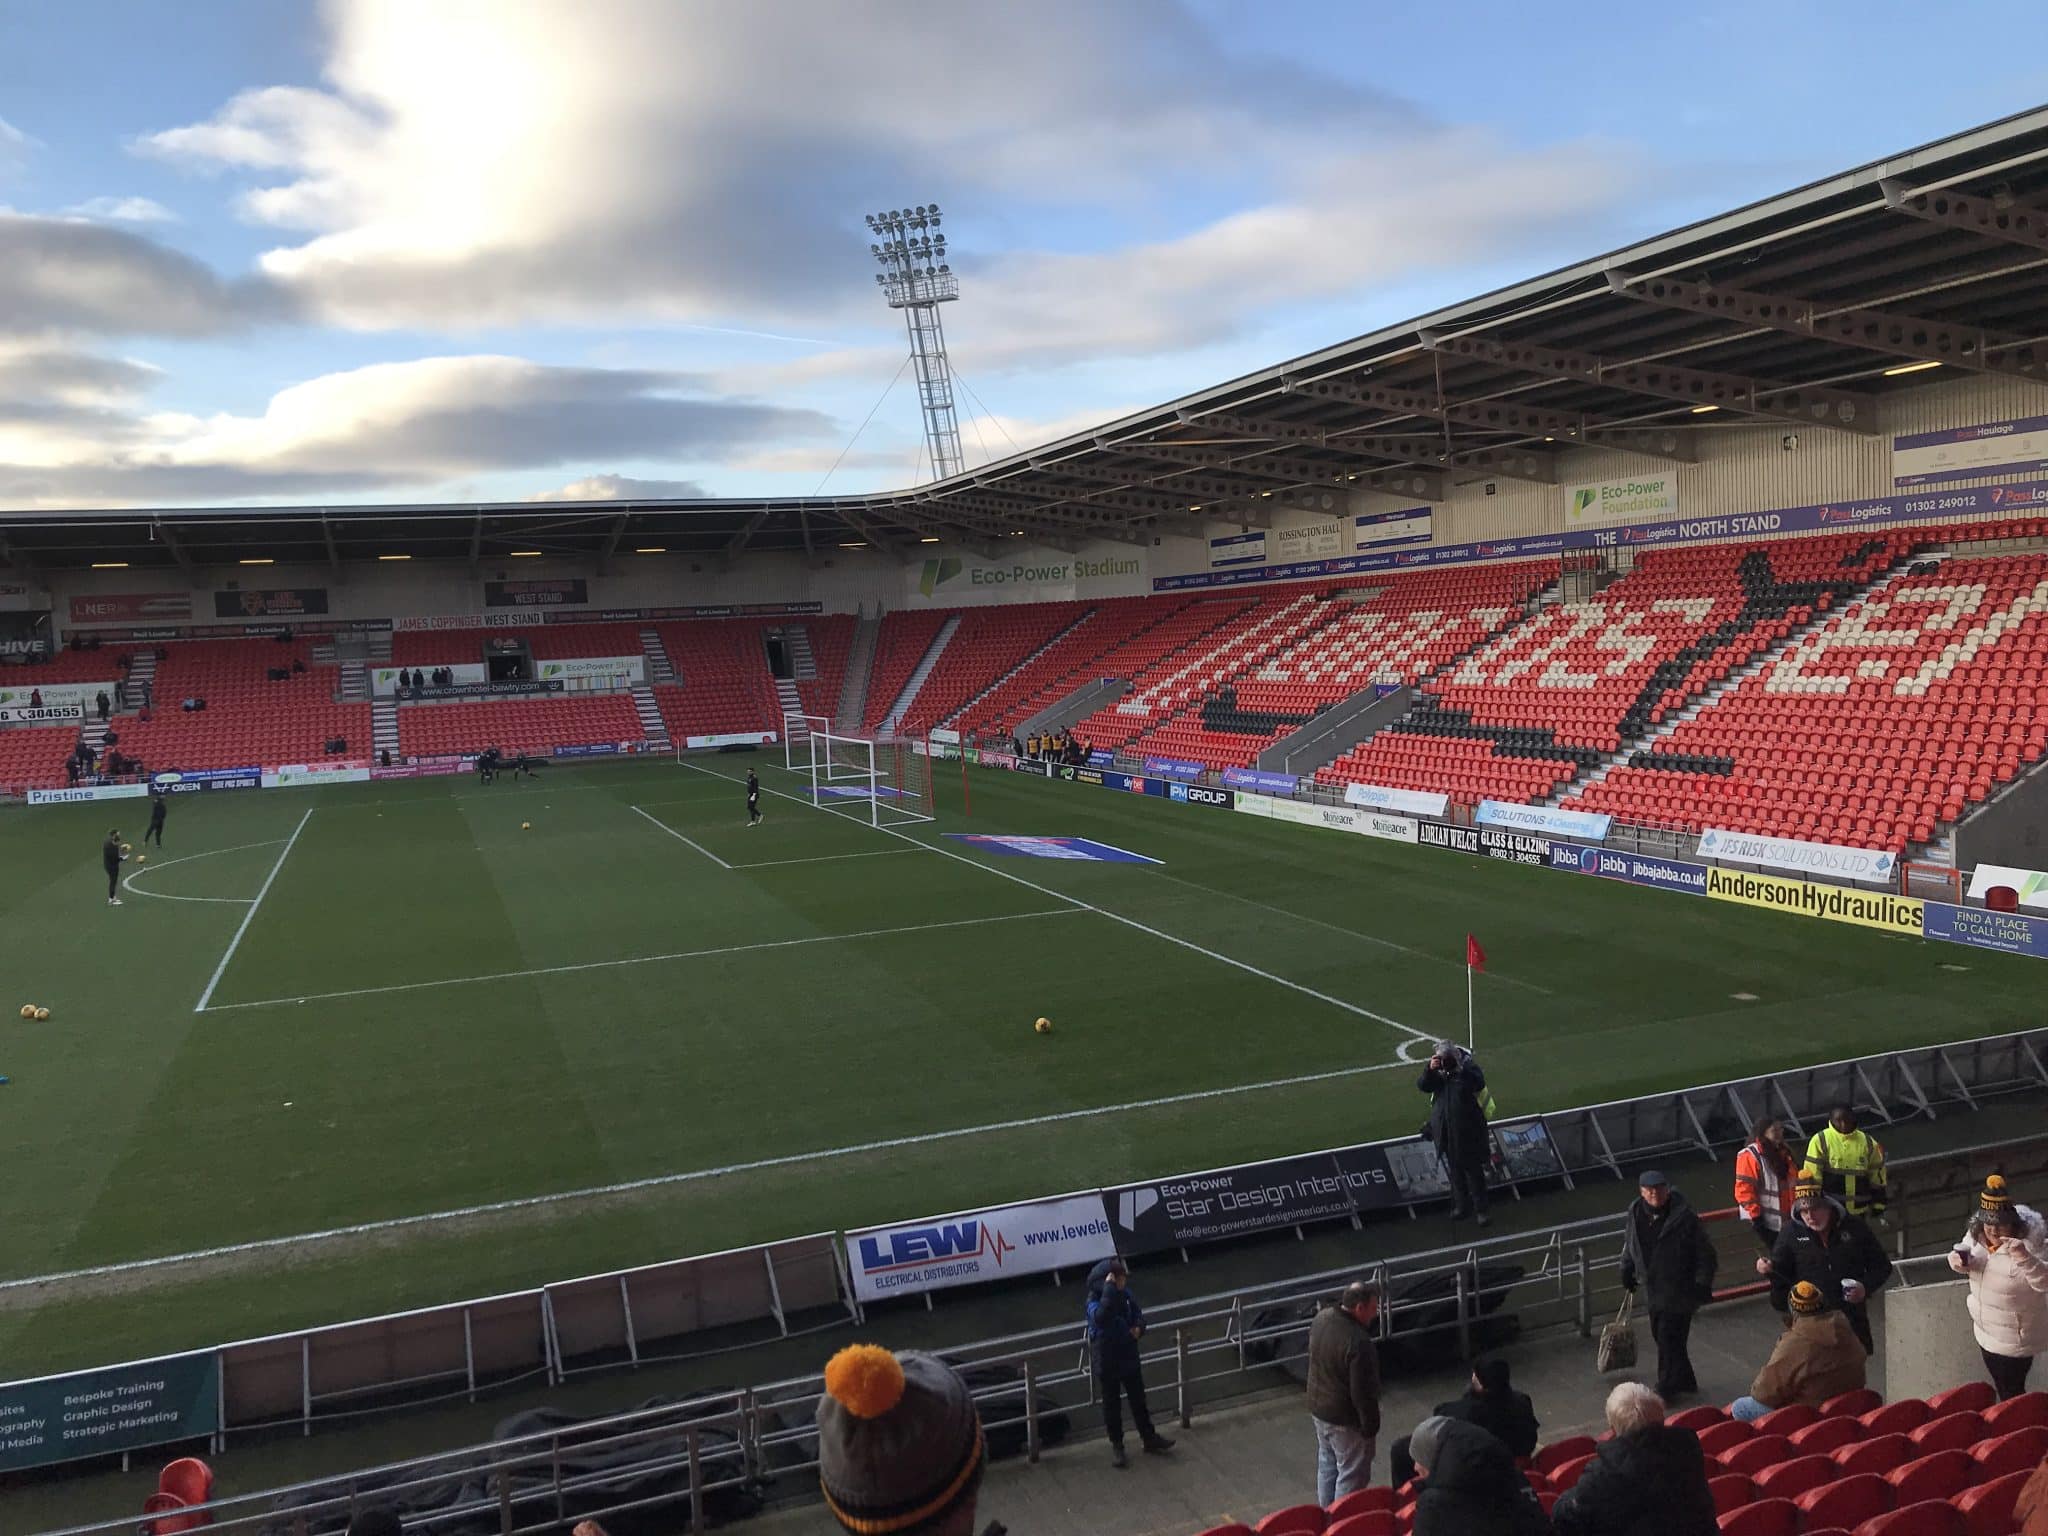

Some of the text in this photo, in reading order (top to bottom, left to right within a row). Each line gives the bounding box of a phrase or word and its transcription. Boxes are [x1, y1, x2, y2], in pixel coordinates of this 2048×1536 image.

[1601, 479, 1665, 501] Eco-Power
[1601, 495, 1669, 515] Foundation
[1905, 496, 1976, 513] 01302 249012
[1278, 523, 1341, 541] ROSSINGTON HALL
[1679, 514, 1781, 539] NORTH STAND
[1594, 531, 1617, 547] THE
[971, 557, 1140, 585] Eco-Power Stadium
[514, 591, 563, 604] WEST STAND
[399, 612, 541, 631] JAMES COPPINGER WEST STAND
[566, 663, 613, 672] Eco-Power
[28, 707, 79, 719] 304555
[171, 782, 201, 792] OXEN
[1123, 778, 1133, 791] sky
[1170, 784, 1227, 804] IPM GROUP
[33, 789, 94, 802] Pristine
[1323, 811, 1354, 825] Stoneacre
[1372, 818, 1407, 834] Stoneacre
[1490, 808, 1546, 825] SOLUTIONS
[1420, 824, 1478, 851] ADRIAN WELCH
[1480, 831, 1550, 855] GLASS & GLAZING
[1490, 848, 1541, 865] 01302 304555
[1741, 840, 1765, 859] RISK
[1766, 844, 1838, 870] SOLUTIONS
[1840, 853, 1870, 873] LTD
[1632, 861, 1705, 886] jibbajabba.co.uk
[1957, 911, 2029, 932] FIND A PLACE
[1953, 921, 2033, 943] TO CALL HOME
[1160, 1175, 1233, 1197] Eco-Power
[1165, 1168, 1386, 1220] Star Design Interiors
[858, 1219, 978, 1270] LEW
[875, 1261, 980, 1290] ELECTRICAL DISTRIBUTORS
[64, 1379, 165, 1407] Bespoke Training
[63, 1398, 152, 1423] Graphic Design
[63, 1410, 178, 1441] Strategic Marketing
[7, 1435, 44, 1450] Media
